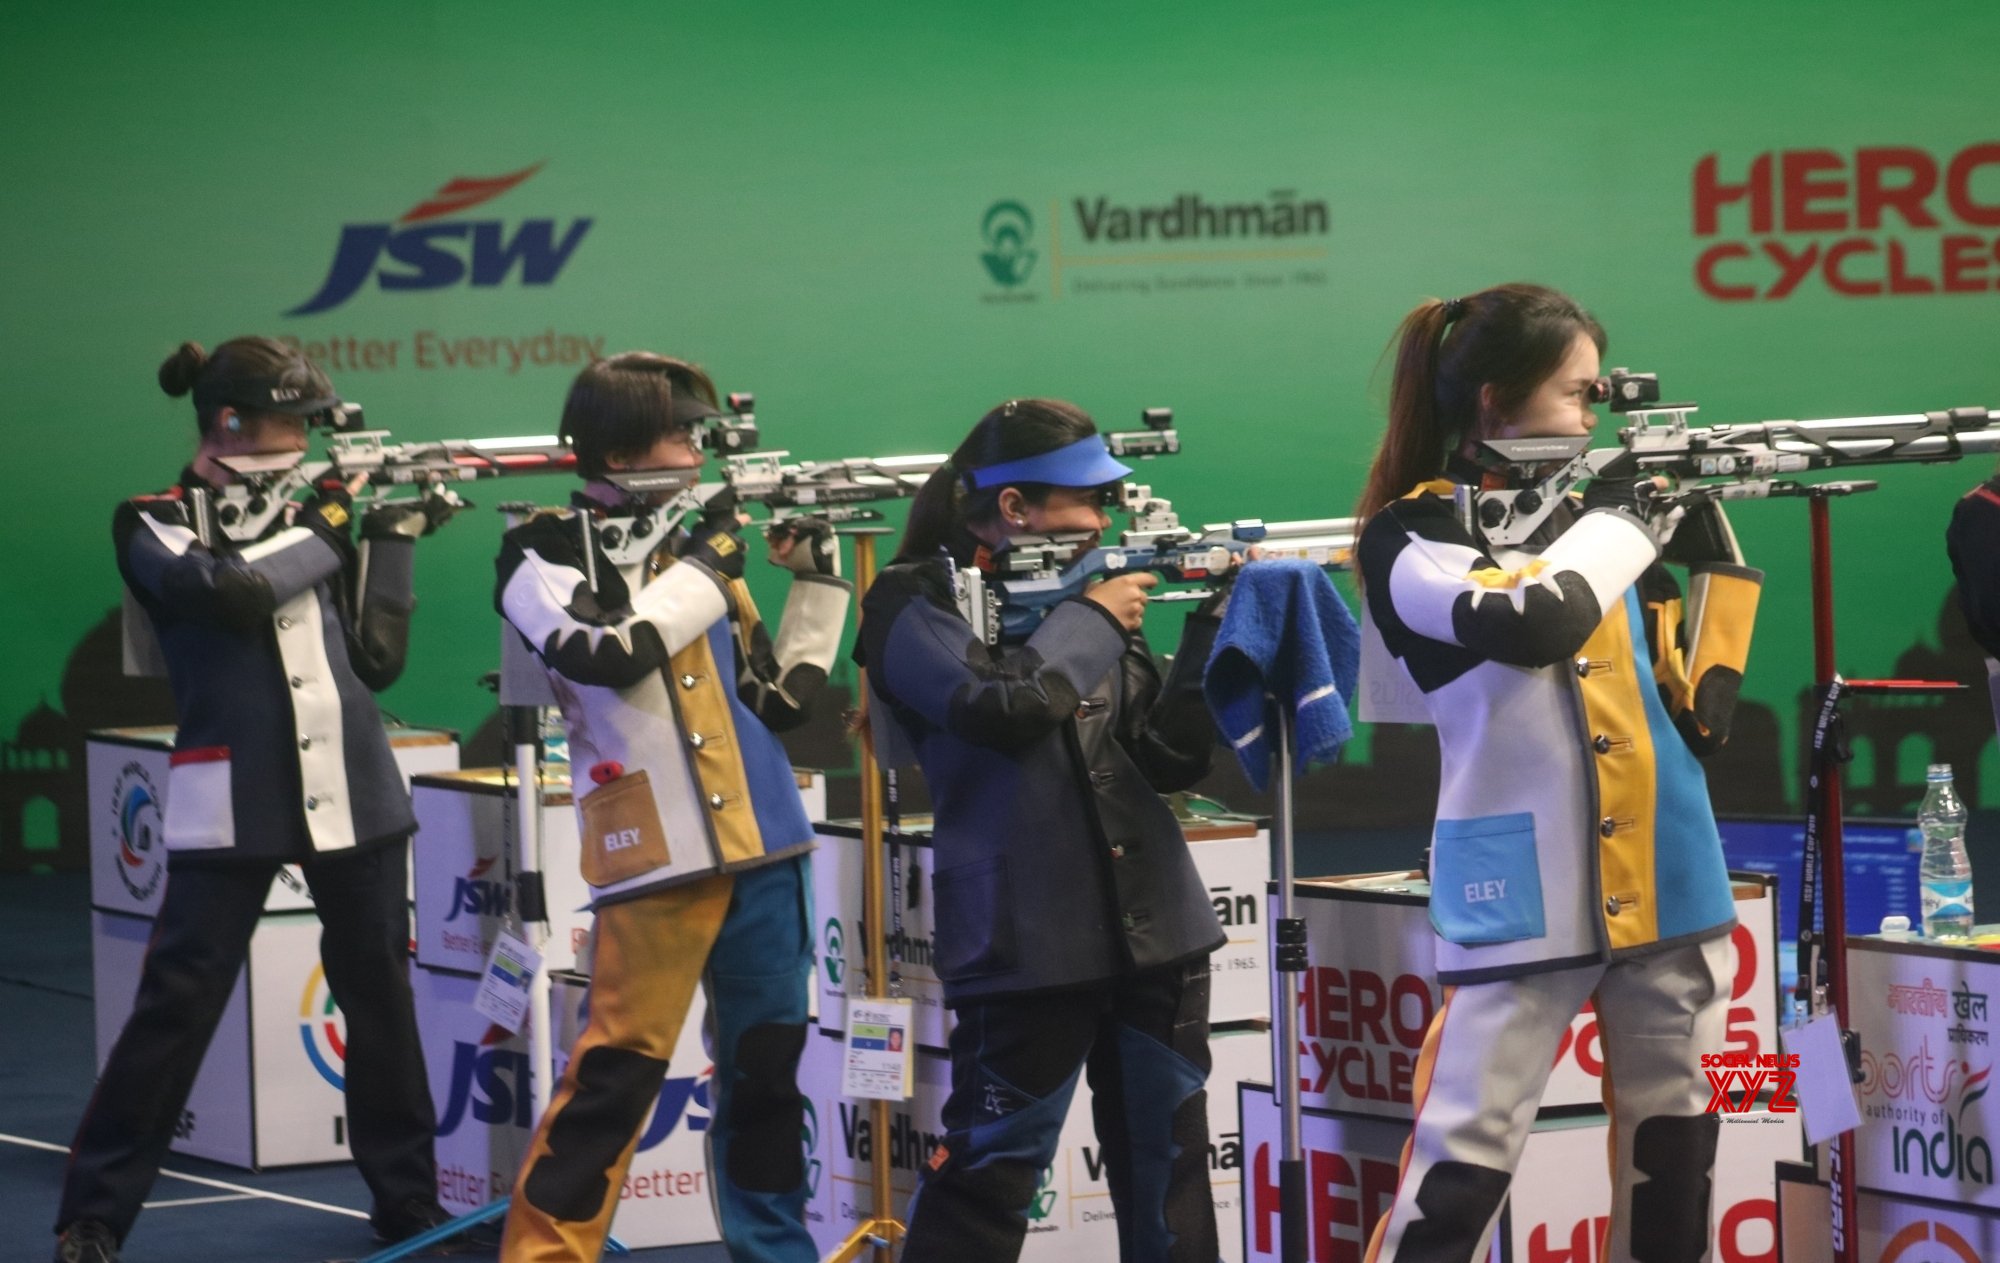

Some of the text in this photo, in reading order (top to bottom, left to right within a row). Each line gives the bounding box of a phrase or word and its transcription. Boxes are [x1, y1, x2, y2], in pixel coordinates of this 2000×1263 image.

[1073, 189, 1330, 243] Vardhmān
[281, 217, 594, 318] JSW
[1694, 234, 2000, 304] CYCLE
[413, 328, 605, 375] Everyday
[604, 827, 641, 852] ELEY
[1806, 834, 1816, 851] CUP
[1464, 879, 1506, 903] ELEY
[1804, 854, 1815, 882] WORLD
[1952, 981, 1988, 1022] खेल
[1298, 1041, 1420, 1104] YCLE
[1858, 1035, 1958, 1110] ports
[634, 1077, 712, 1153] JS
[1866, 1103, 1945, 1127] authority of
[435, 1162, 486, 1207] etter
